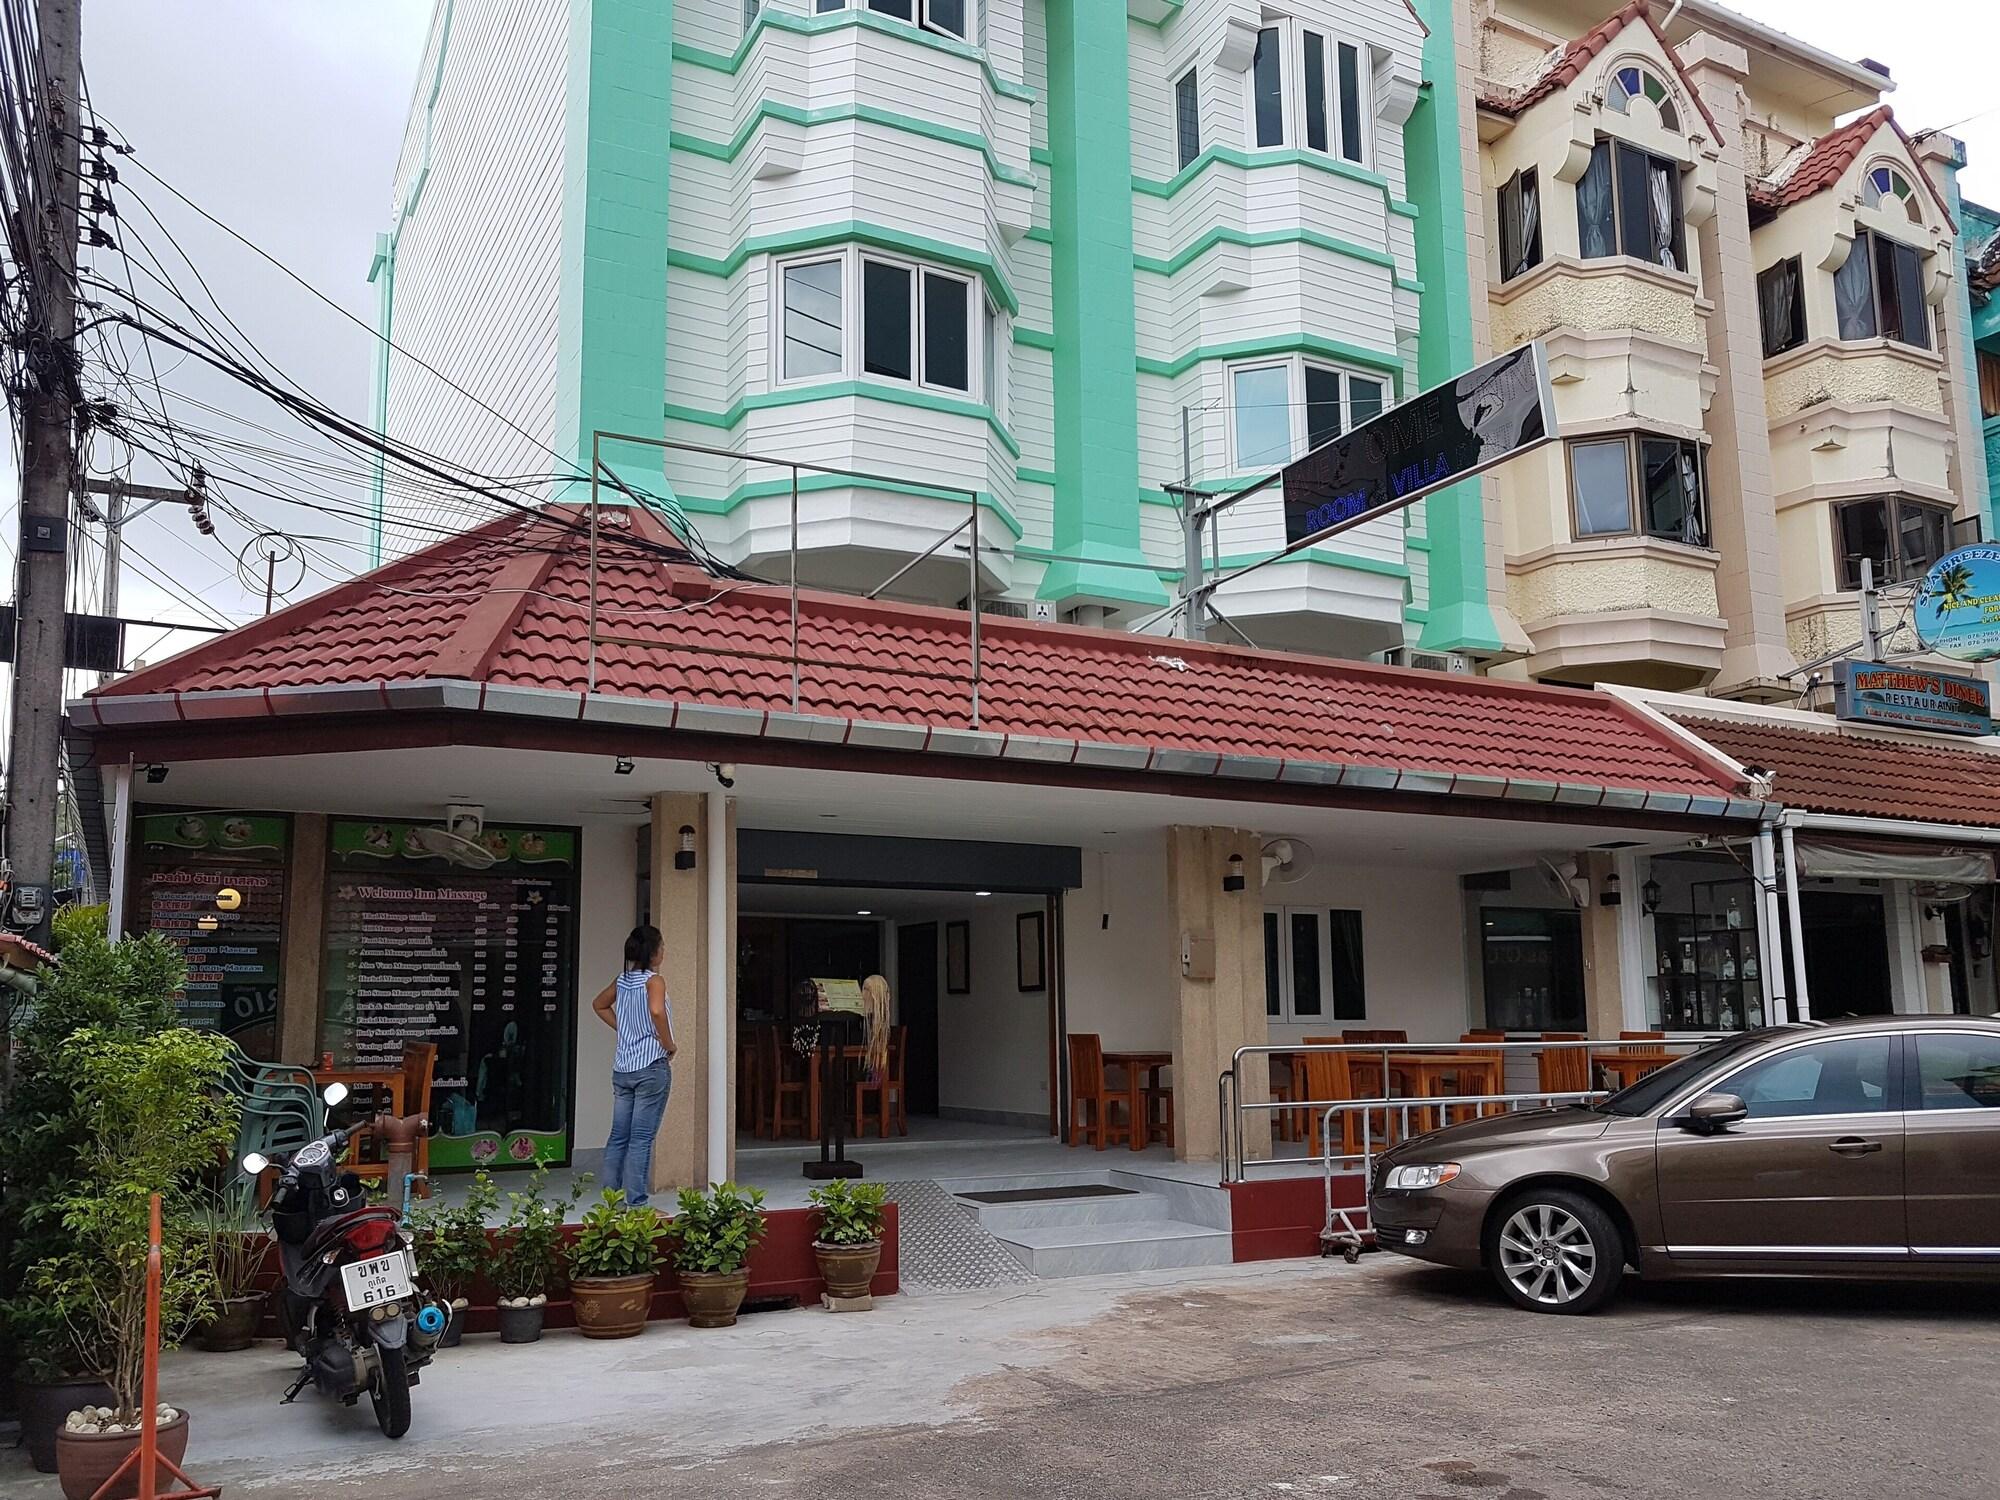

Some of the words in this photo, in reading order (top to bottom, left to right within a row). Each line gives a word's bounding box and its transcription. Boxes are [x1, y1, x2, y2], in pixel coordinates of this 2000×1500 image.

[1306, 487, 1366, 533] ROOM
[1391, 452, 1451, 496] VILLA
[1919, 573, 1941, 608] SEA
[1962, 597, 1979, 608] AND
[1980, 594, 2000, 605] CLEA
[1855, 671, 1941, 695] MATTHEW'S
[1943, 681, 1986, 707] DINER
[1884, 692, 1960, 713] RESTAURANT
[357, 886, 414, 899] Welcome
[414, 887, 437, 900] Inn
[437, 888, 488, 904] Massage
[384, 948, 413, 958] Massage
[393, 962, 422, 973] Massage
[392, 988, 420, 999] Massage
[396, 1029, 425, 1040] Massage
[363, 1285, 396, 1303] 616
